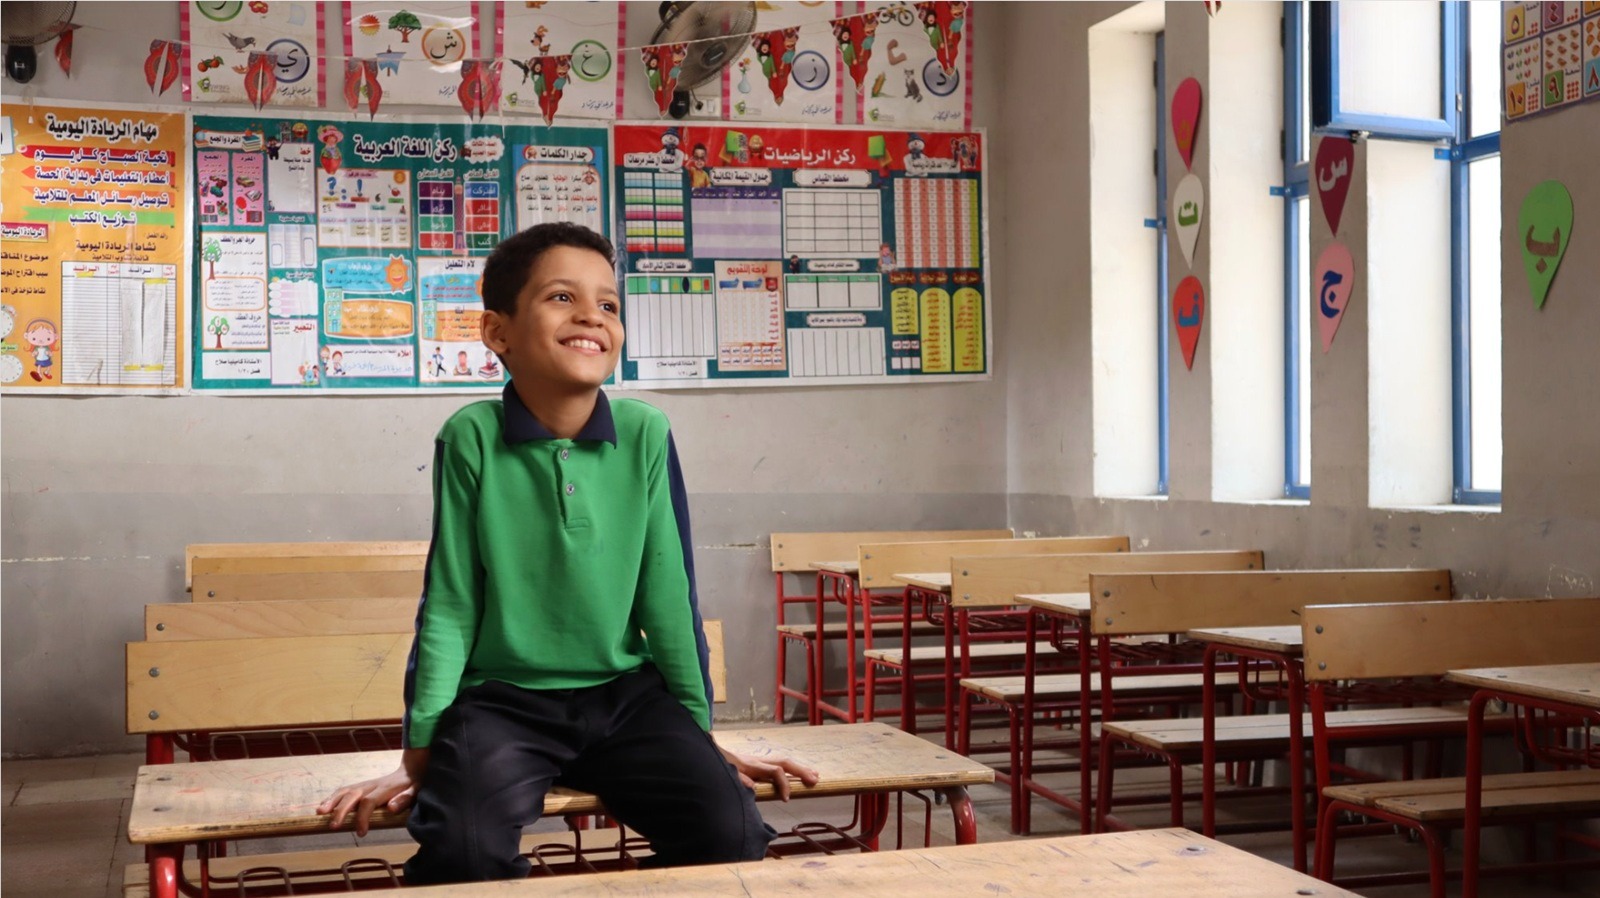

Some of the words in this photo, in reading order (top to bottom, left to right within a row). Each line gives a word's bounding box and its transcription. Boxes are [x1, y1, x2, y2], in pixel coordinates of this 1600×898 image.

[429, 31, 458, 58] ش
[276, 48, 299, 73] ي
[580, 44, 600, 77] غ
[1548, 76, 1559, 99] ٩
[47, 115, 90, 139] اليومية
[91, 119, 131, 141] الريادة
[133, 122, 157, 141] مهام
[76, 148, 99, 162] كل
[353, 135, 401, 162] العربية
[402, 137, 432, 157] اللغة
[433, 138, 457, 162] ركن
[540, 147, 569, 159] الكلمات
[36, 150, 75, 163] يوم
[100, 150, 142, 165] الصباح
[145, 151, 168, 166] تحية
[570, 149, 588, 162] جدار
[763, 146, 832, 165] الرياضيات
[833, 148, 856, 165] ركن
[36, 166, 63, 179] الحصة
[65, 168, 88, 185] بداية
[103, 171, 142, 186] التعليمات
[753, 170, 769, 183] جدول
[1318, 157, 1349, 192] س
[34, 188, 68, 204] للتلاميذ
[69, 191, 99, 205] المعلم
[101, 192, 137, 206] رسائل
[138, 193, 168, 207] توصيل
[69, 211, 101, 227] الكتب
[102, 212, 136, 227] توزيع
[75, 239, 105, 252] اليومية
[105, 240, 134, 253] الريادة
[134, 242, 156, 252] نشاط
[1525, 224, 1561, 274] ب
[1320, 270, 1343, 319] ج
